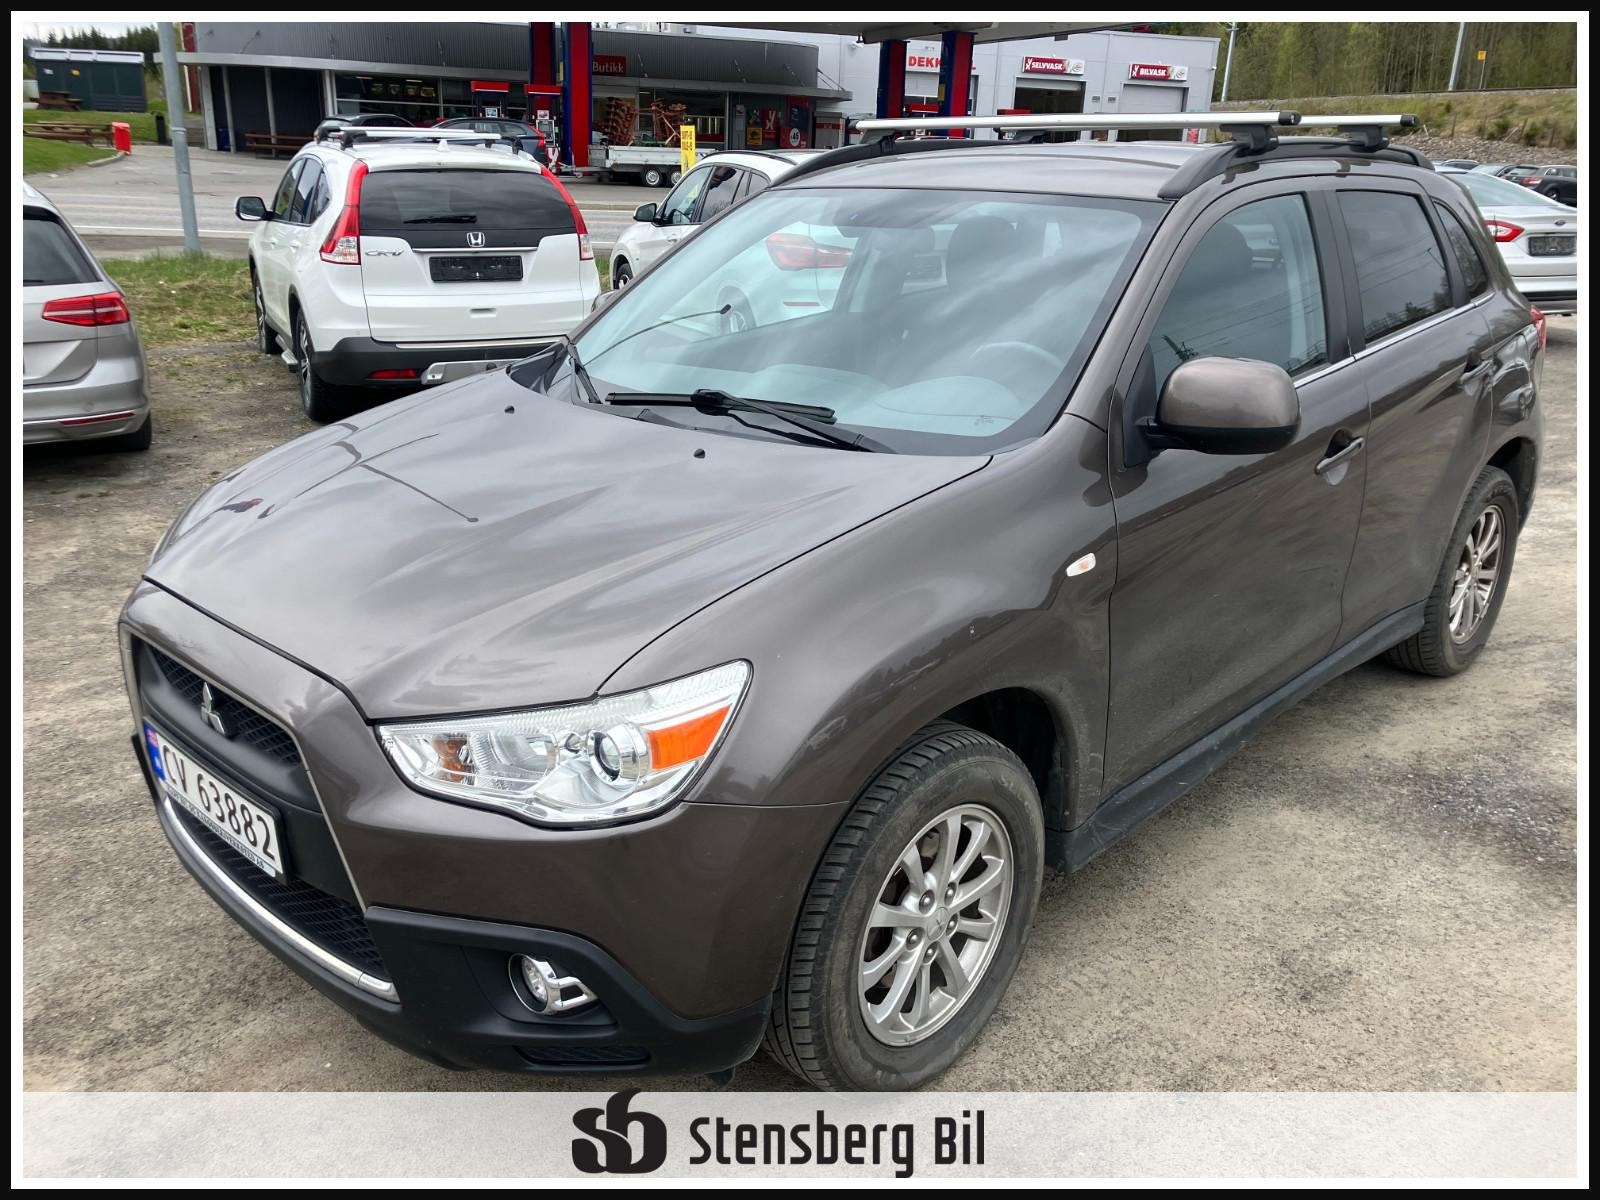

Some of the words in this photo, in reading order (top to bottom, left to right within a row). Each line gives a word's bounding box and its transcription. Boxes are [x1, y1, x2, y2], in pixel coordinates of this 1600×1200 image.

[592, 61, 624, 73] Butikk
[1140, 67, 1167, 77] BILVASK
[163, 744, 188, 793] CV
[197, 773, 275, 861] 63882
